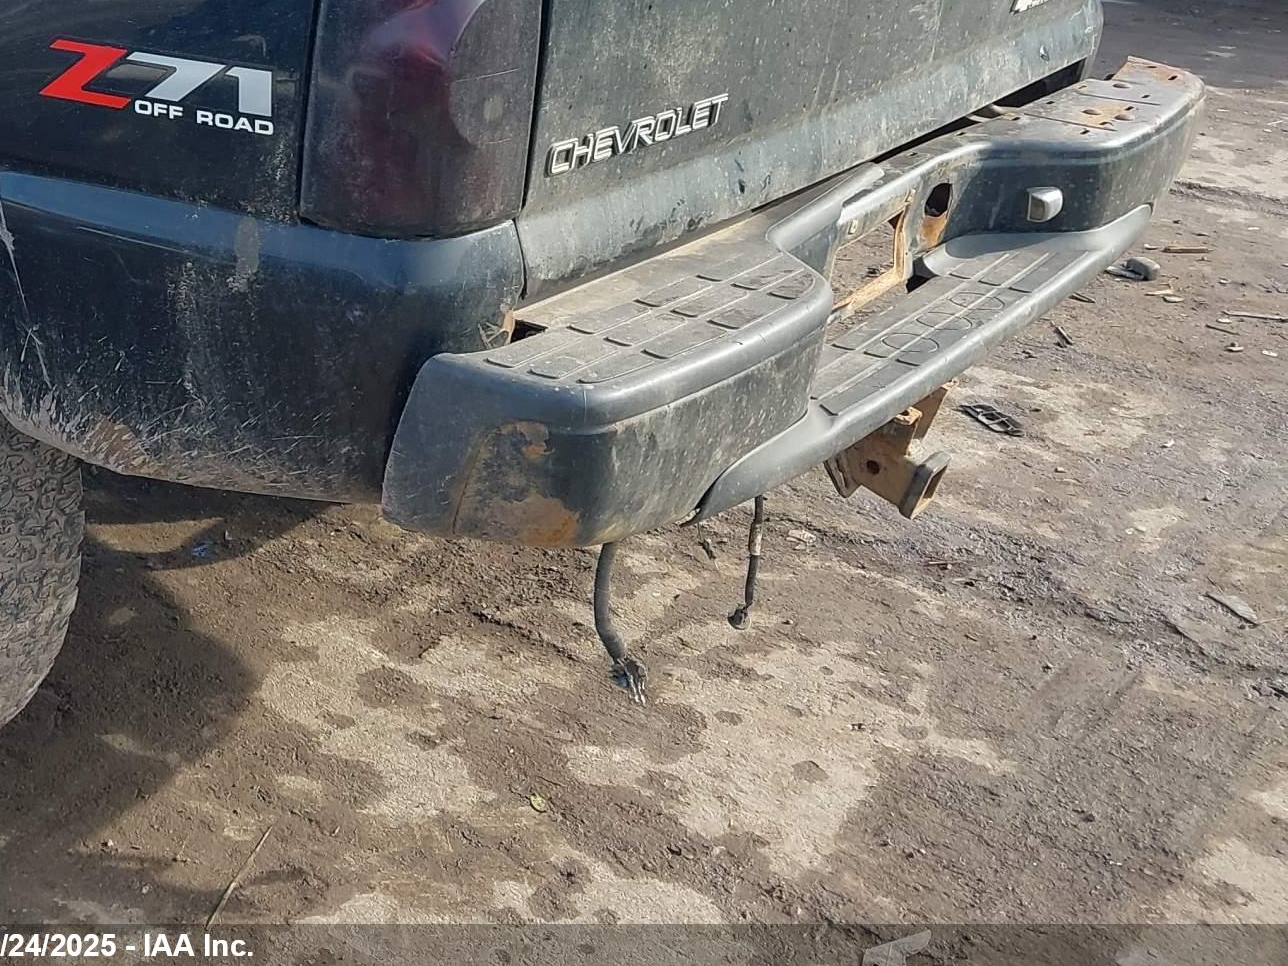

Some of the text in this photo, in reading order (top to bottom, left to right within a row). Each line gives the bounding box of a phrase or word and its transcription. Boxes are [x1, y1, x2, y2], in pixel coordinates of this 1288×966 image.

[38, 38, 273, 118] Z71
[134, 98, 274, 136] OFF ROAD
[546, 92, 730, 178] CHEVROLET
